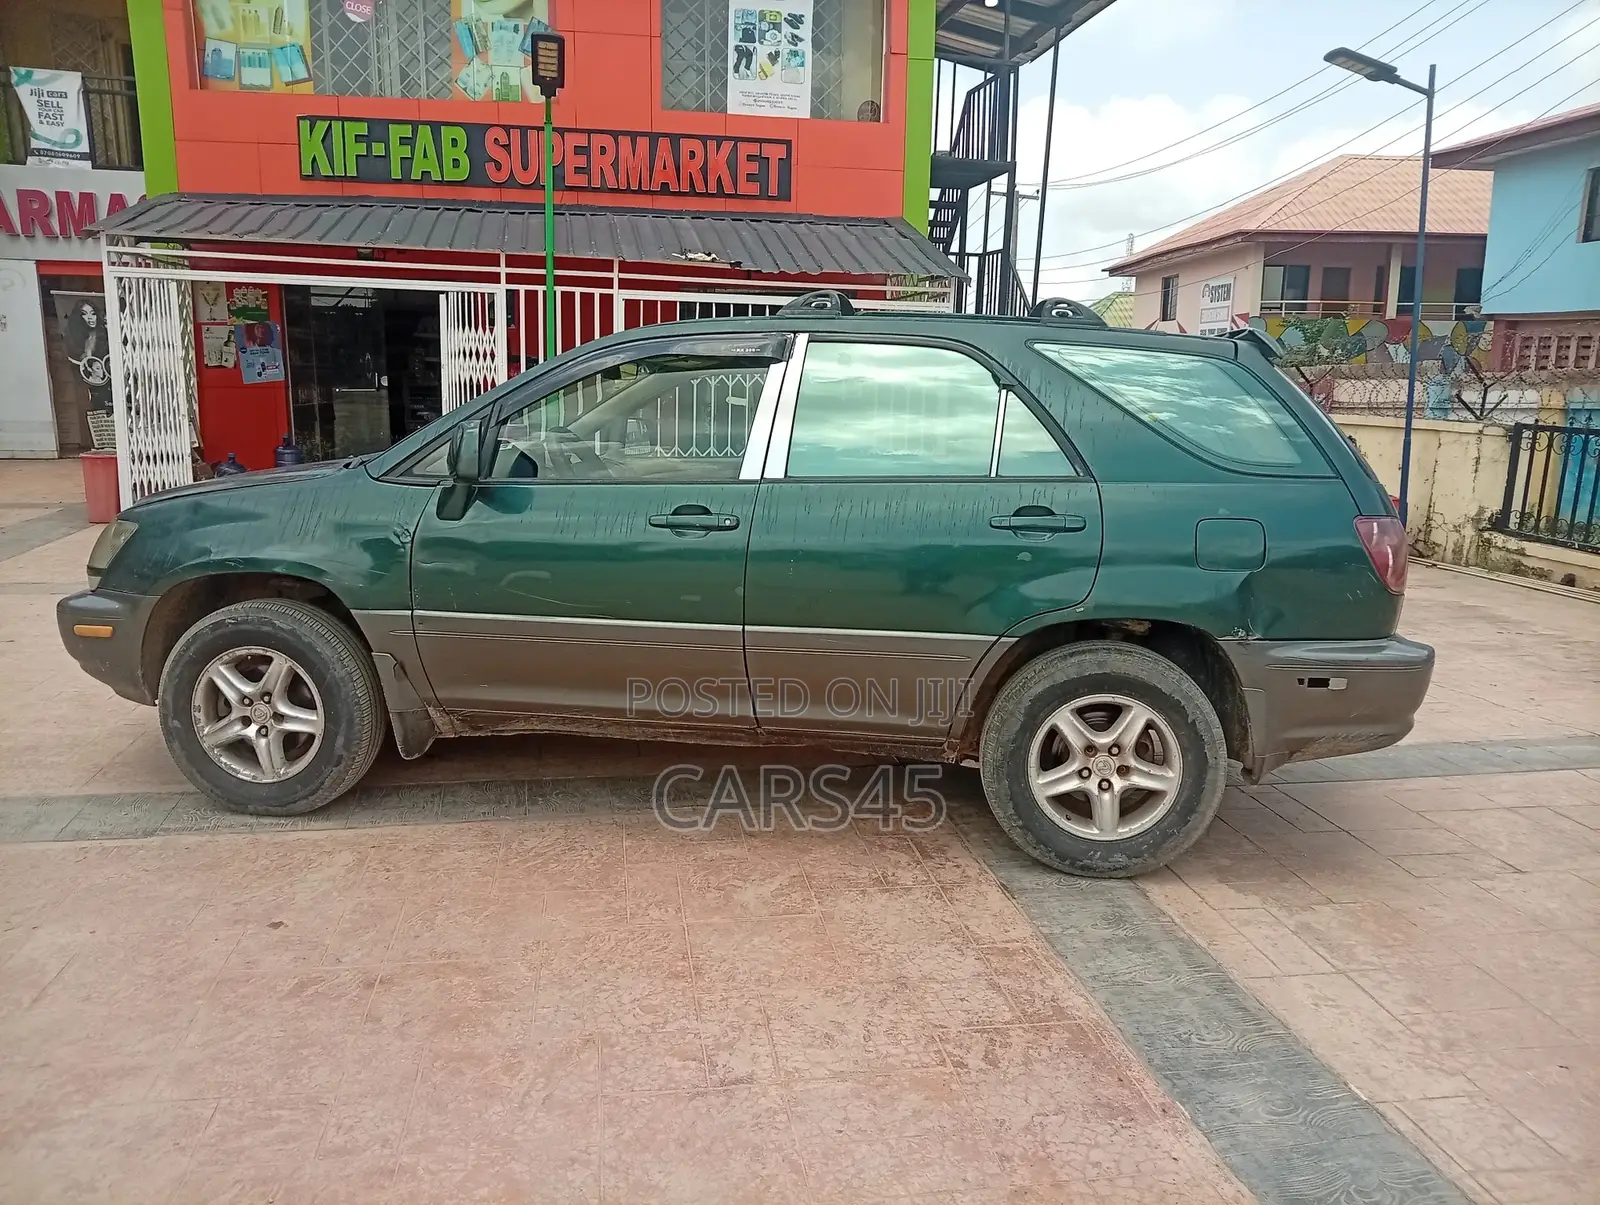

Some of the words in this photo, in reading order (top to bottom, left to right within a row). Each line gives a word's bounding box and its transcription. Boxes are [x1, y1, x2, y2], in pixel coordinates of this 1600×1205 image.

[345, 1, 372, 15] CLOSE
[37, 99, 63, 109] SELL
[38, 112, 65, 121] FAST
[299, 118, 471, 182] KIF-FAB
[484, 126, 787, 197] SUPERMARKET
